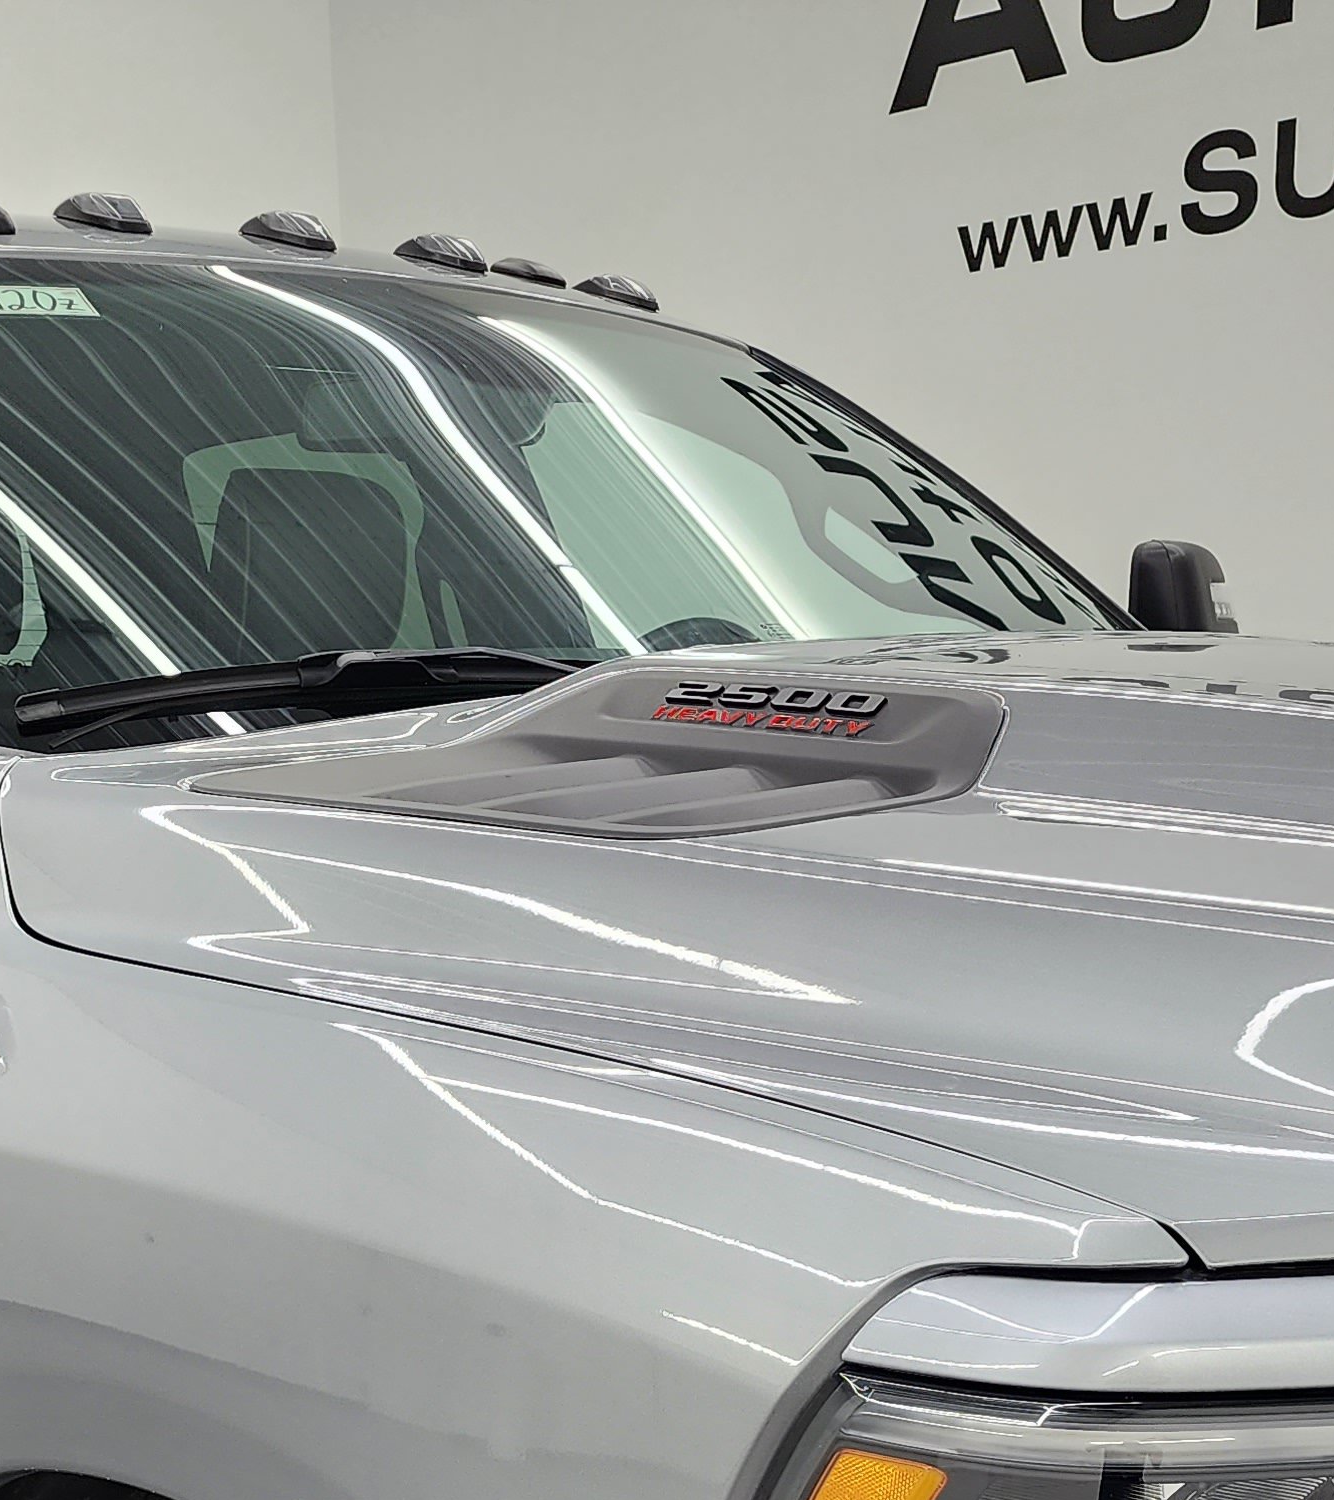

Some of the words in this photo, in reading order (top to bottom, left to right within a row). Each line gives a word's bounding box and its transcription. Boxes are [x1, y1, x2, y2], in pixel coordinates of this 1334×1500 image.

[664, 681, 888, 717] 2500
[651, 705, 765, 727] HEAVY
[766, 713, 874, 736] DUTY
